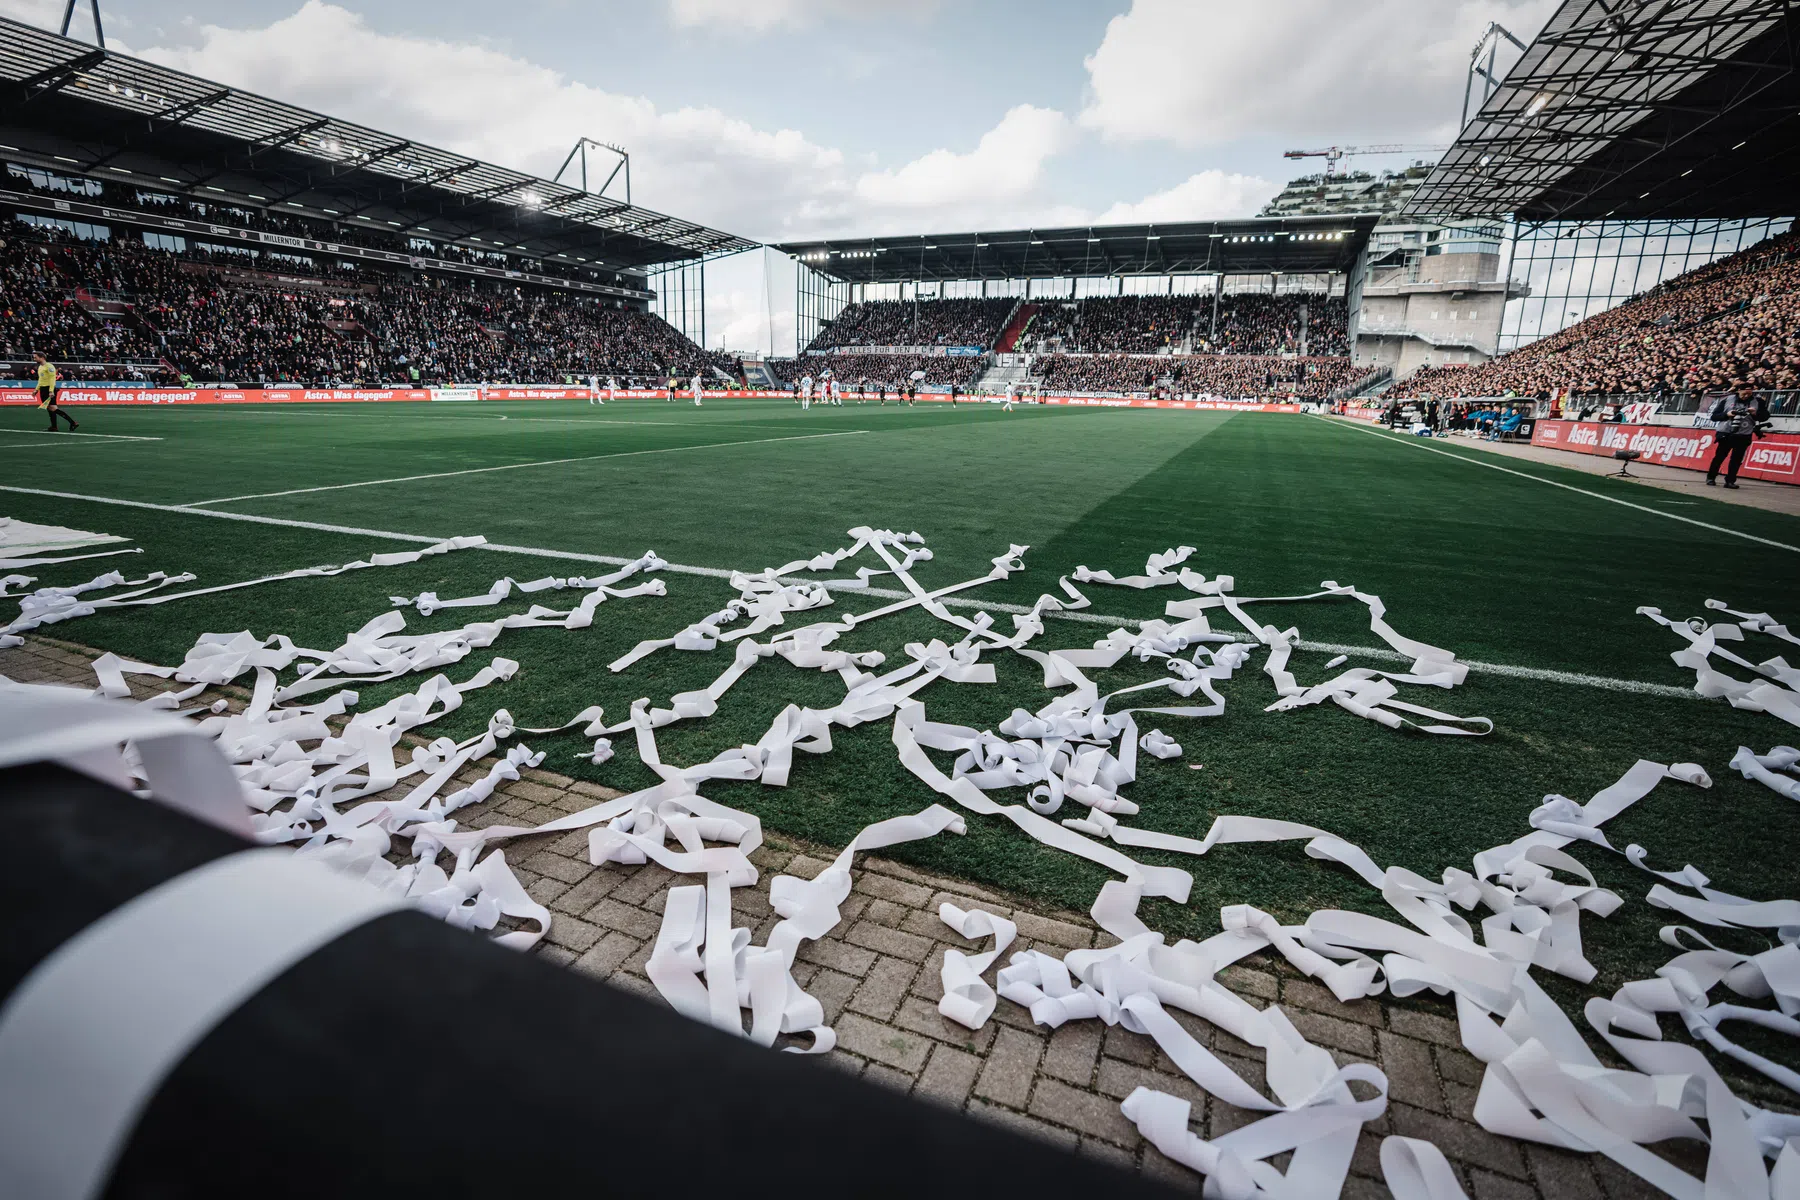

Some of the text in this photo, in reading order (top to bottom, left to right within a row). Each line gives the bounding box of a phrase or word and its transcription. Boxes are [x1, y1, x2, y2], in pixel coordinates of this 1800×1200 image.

[264, 234, 301, 247] MILLERNTOR
[59, 391, 197, 403] Astra. Was dagegen?
[304, 391, 393, 400] Astra. Was dagegen?
[1567, 424, 1712, 462] Astra. Was dagegen?
[1750, 448, 1793, 466] ASTRA
